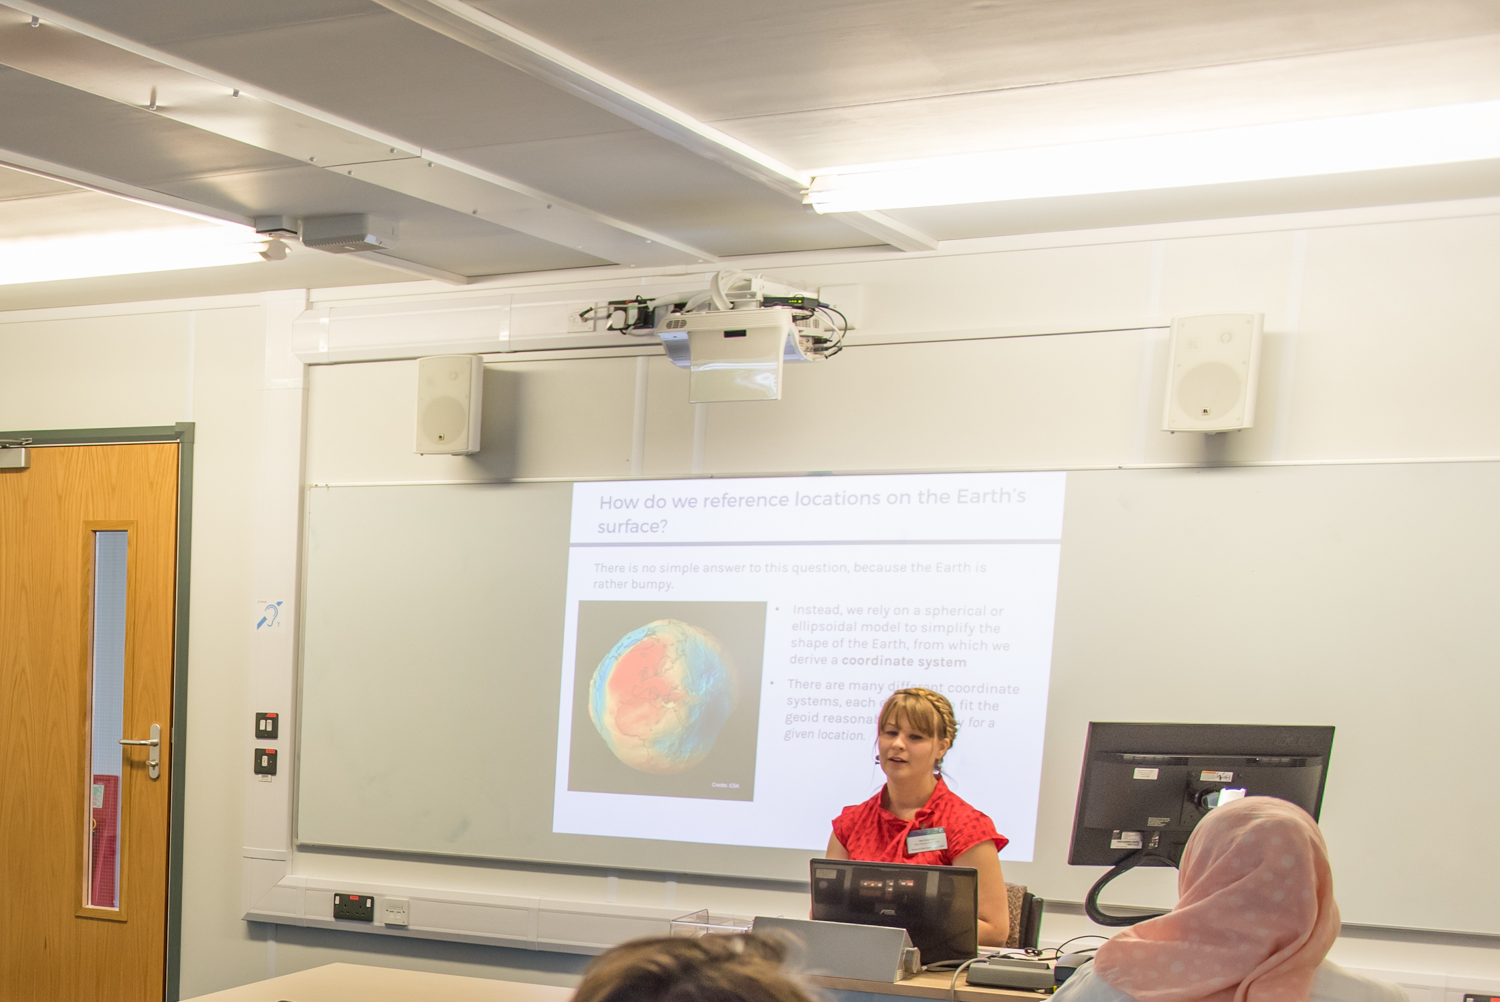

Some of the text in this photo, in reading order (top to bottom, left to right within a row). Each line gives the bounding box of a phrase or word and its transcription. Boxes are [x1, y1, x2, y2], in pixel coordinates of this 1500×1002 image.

[599, 487, 1027, 510] How do we reference locations on the Earth's
[597, 518, 668, 534] surface?
[594, 562, 987, 576] There is no simple answer to this question, because the Earth is
[593, 579, 674, 593] rather bumpy.
[793, 604, 1004, 620] Instead, we rely on a spherical or
[791, 621, 1001, 637] ellipsoidal model to simplify the
[791, 638, 1010, 652] shape of the Earth, from which we
[789, 654, 967, 670] derive a coordinate system
[788, 678, 821, 690] There
[825, 681, 845, 691] are
[848, 681, 885, 695] many
[947, 682, 1020, 695] coordinate
[786, 696, 843, 710] systems,
[845, 696, 876, 708] each
[960, 699, 973, 711] fit
[978, 700, 999, 712] the
[784, 713, 819, 726] geoid
[968, 717, 985, 729] for
[988, 719, 995, 729] a
[783, 729, 866, 742] given location.
